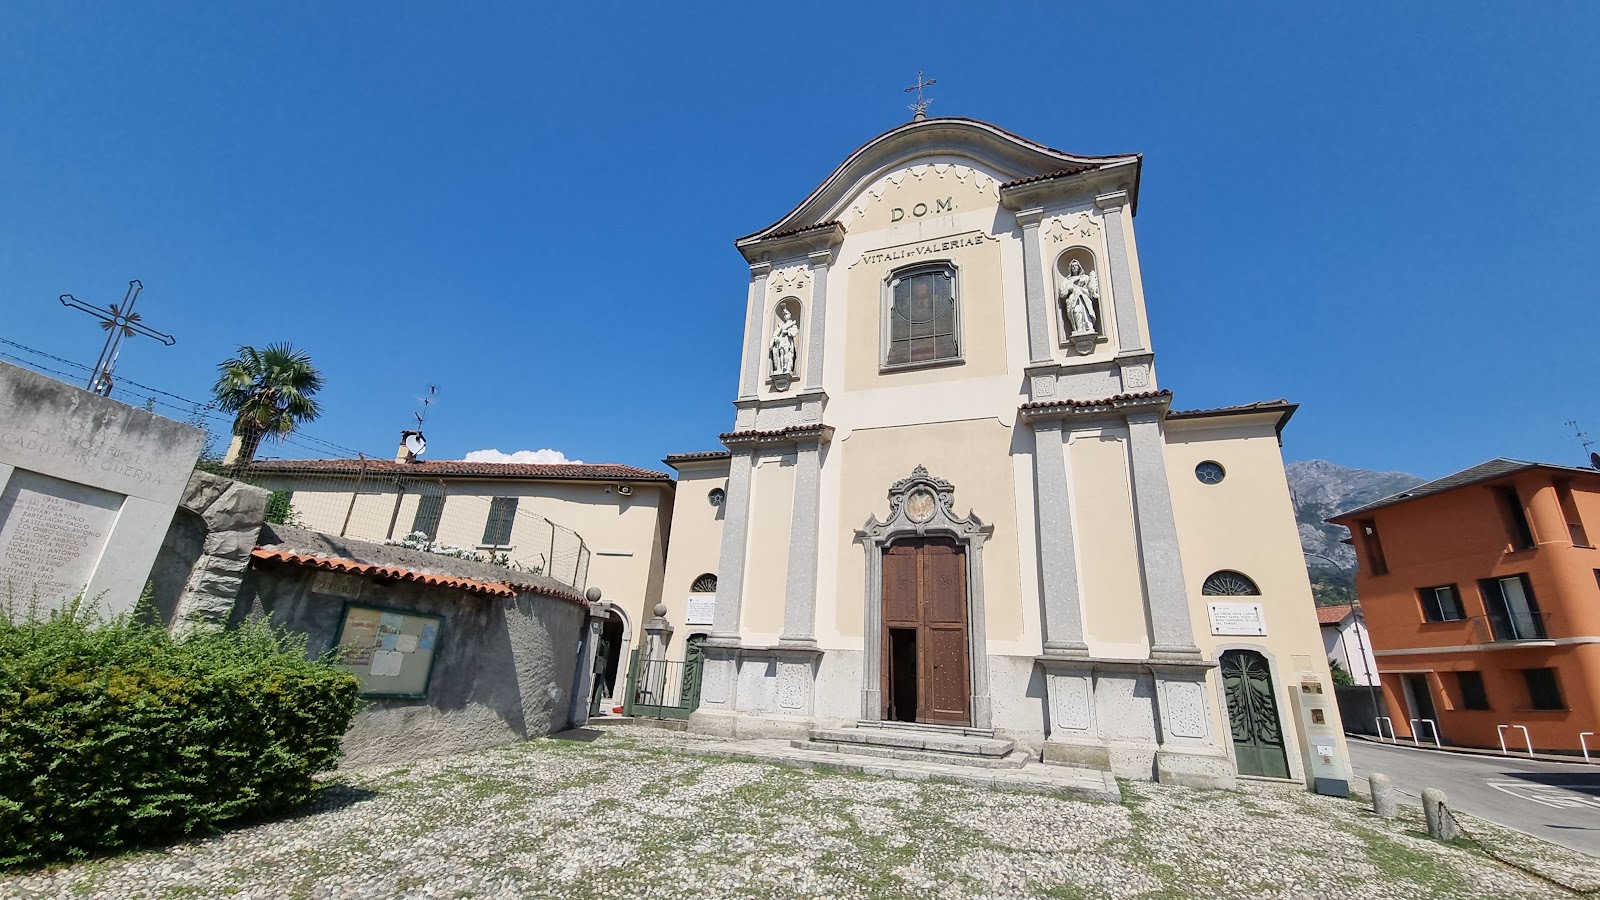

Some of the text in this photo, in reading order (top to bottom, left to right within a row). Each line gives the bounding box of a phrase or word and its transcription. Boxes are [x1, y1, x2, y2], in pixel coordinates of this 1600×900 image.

[863, 250, 905, 265] VITALI
[915, 236, 983, 255] VALERIAE
[101, 461, 162, 485] GUERRA
[53, 511, 85, 522] ANTONIO
[65, 520, 90, 529] PAOLO
[71, 527, 101, 537] ANTONIO
[48, 548, 79, 557] ANTONIO
[10, 560, 30, 568] 1940
